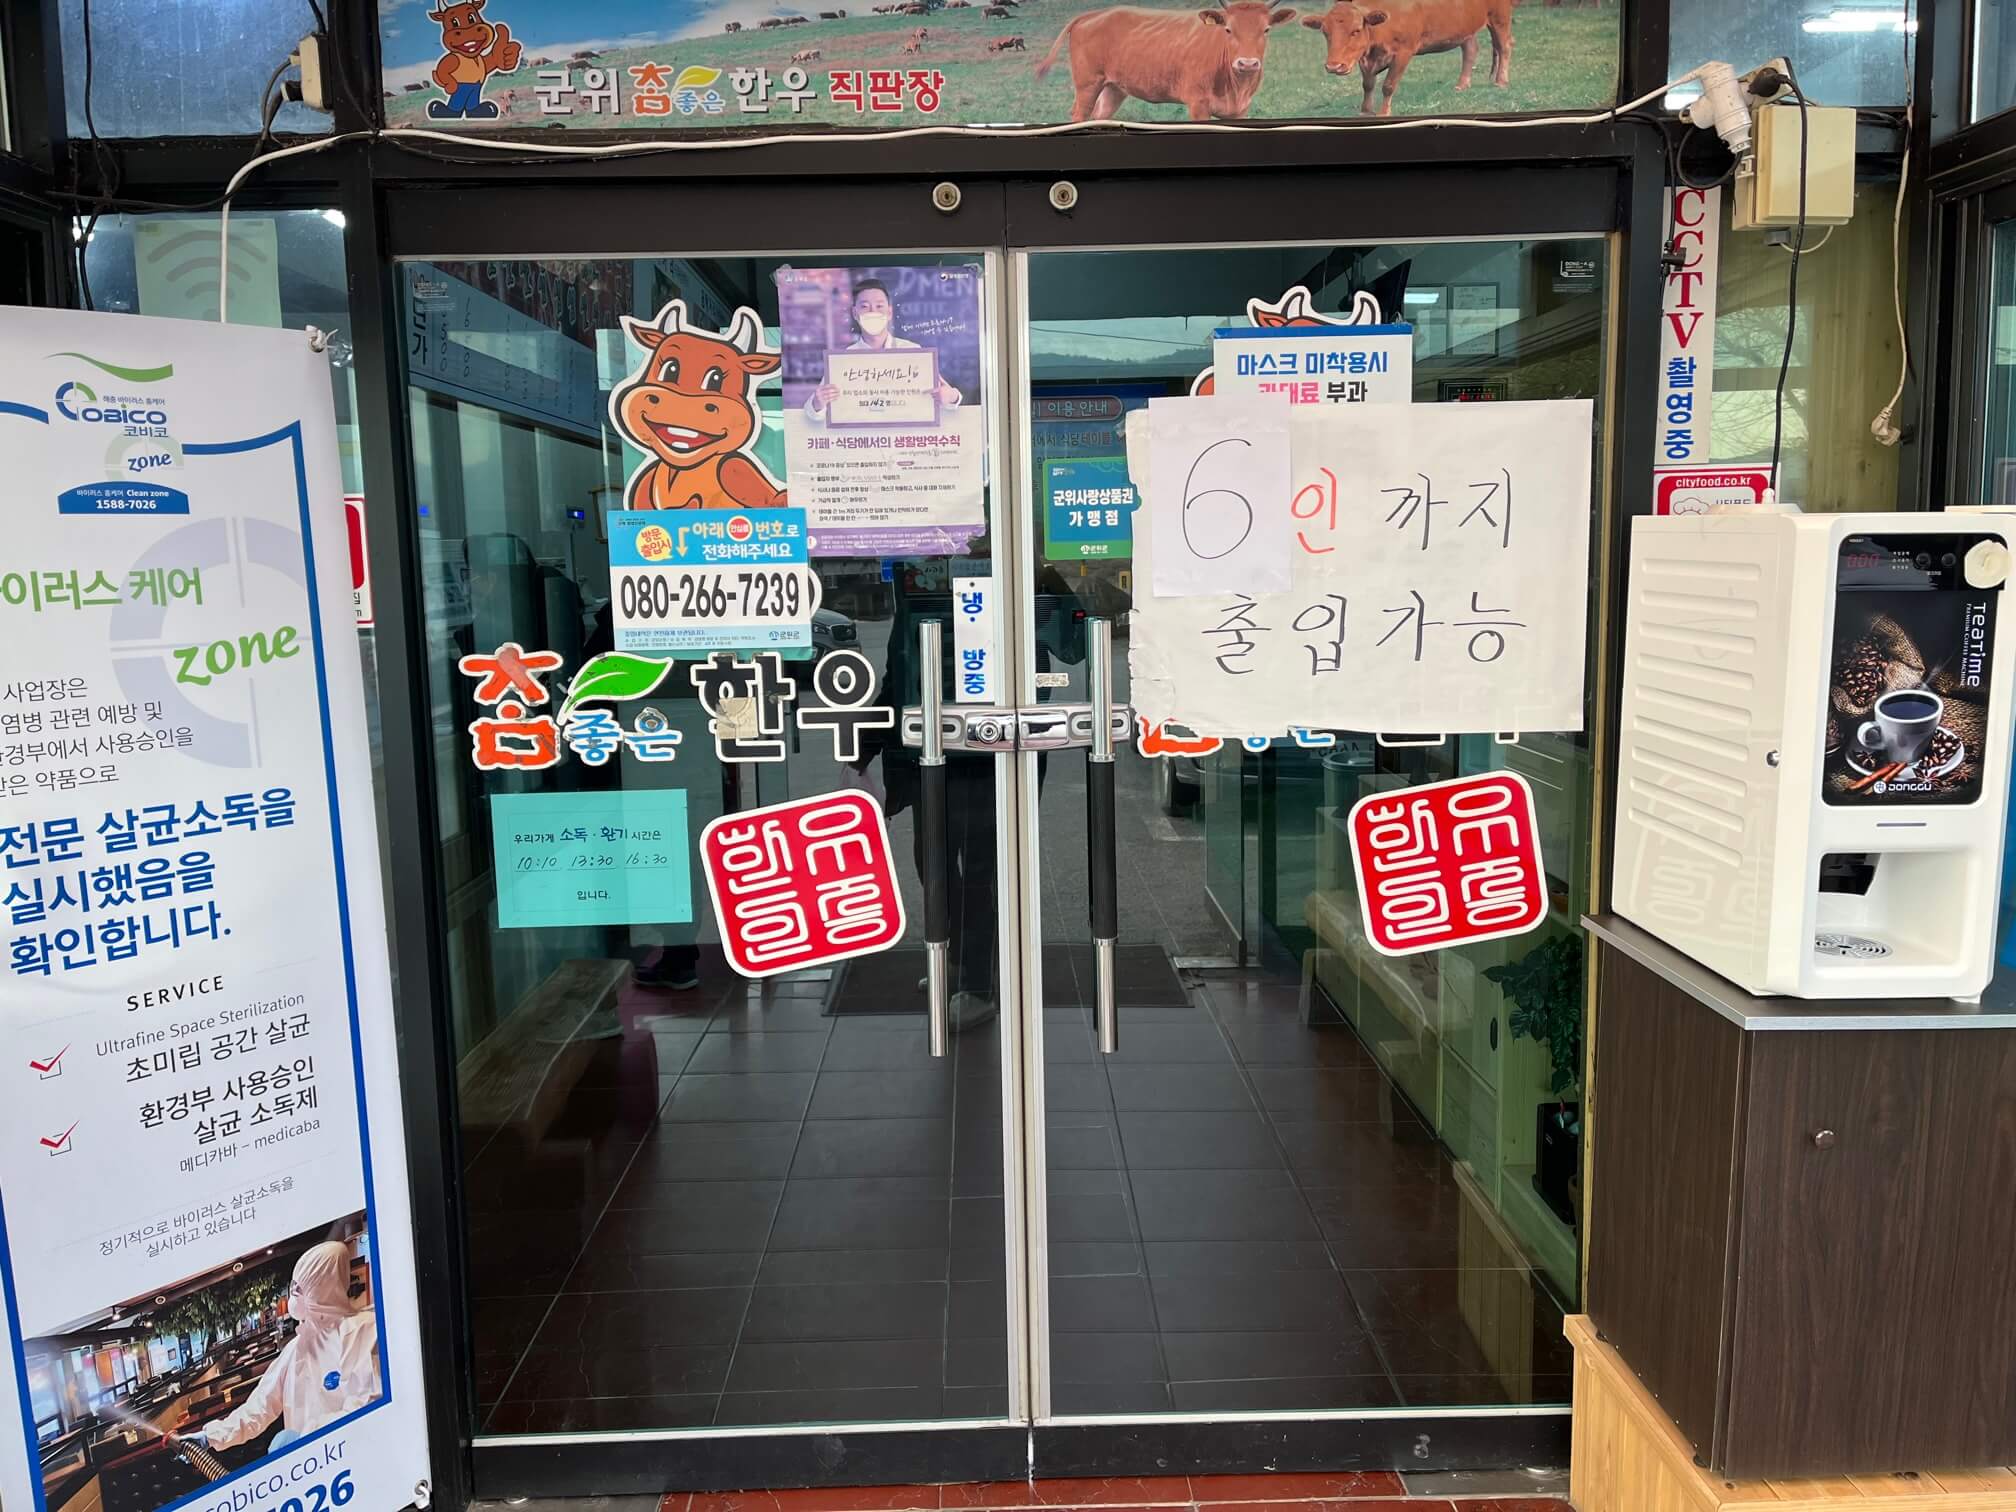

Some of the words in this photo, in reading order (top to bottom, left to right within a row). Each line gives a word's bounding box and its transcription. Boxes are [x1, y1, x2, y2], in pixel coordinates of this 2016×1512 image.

[532, 68, 620, 115] 군위
[729, 67, 816, 114] 한우
[829, 69, 945, 113] 직판장
[1666, 189, 1705, 349] CCTV
[1237, 353, 1298, 376] 마스크
[1306, 351, 1388, 374] 미착용시
[1326, 381, 1368, 403] 부과
[1048, 400, 1076, 417] 이용
[1079, 400, 1108, 416] 안내
[1663, 356, 1697, 461] 촬영중
[123, 426, 168, 438] 코비코
[894, 435, 960, 449] 생활방역수칙
[128, 453, 172, 472] zone
[1053, 488, 1134, 506] 군위사랑상품권
[1675, 476, 1752, 488] cityfood.co.kr
[96, 500, 156, 509] 1588-7026
[1381, 467, 1512, 550] 까지
[641, 525, 662, 542] 방문
[692, 521, 724, 540] 아래
[755, 520, 800, 540] 번호로
[641, 539, 672, 558] 출입시
[702, 543, 793, 561] 전화해주세요
[0, 569, 122, 611] 이러스
[128, 567, 202, 607] 케어
[620, 572, 800, 619] 080-266-7239
[1202, 593, 1347, 676] 출입
[1376, 590, 1527, 662] 가능
[173, 625, 300, 686] zone
[4, 677, 88, 703] 사업장은
[690, 649, 895, 763] 한우
[50, 707, 91, 730] 관련
[98, 703, 137, 724] 예방
[145, 701, 163, 722] 및
[96, 726, 194, 755] 사용승인을
[36, 764, 119, 791] 약품으로
[0, 817, 85, 869] 전문
[96, 788, 296, 854] 살균소독을
[513, 833, 554, 844] 우리가게
[560, 827, 588, 842] 소독
[600, 826, 628, 842] 환기
[631, 830, 661, 841] 시간은
[571, 855, 613, 867] 13:30
[625, 852, 667, 865] 16:30
[3, 851, 216, 925] 실시했음을
[577, 890, 611, 900] 입니다.
[10, 901, 231, 978] 확인합니다.
[127, 975, 224, 1011] SERVICE
[96, 1029, 165, 1056] Ultrafine
[169, 1016, 215, 1039] Space
[219, 993, 304, 1025] Sterilization
[127, 1042, 201, 1083] 초미립
[210, 1027, 258, 1061] 공간
[265, 1013, 310, 1045] 살균
[139, 1086, 215, 1129] 환경부
[222, 1056, 314, 1101] 사용승인
[193, 1110, 242, 1145] 살균
[250, 1085, 318, 1126] 소독제
[180, 1143, 238, 1173] 메디카바
[254, 1119, 321, 1149] medicaba
[100, 1220, 170, 1256] 정기적으로
[173, 1202, 227, 1228] 바이러스
[230, 1176, 294, 1210] 살균소독을
[146, 1228, 200, 1258] 실시하고
[204, 1206, 257, 1237] 있습니다
